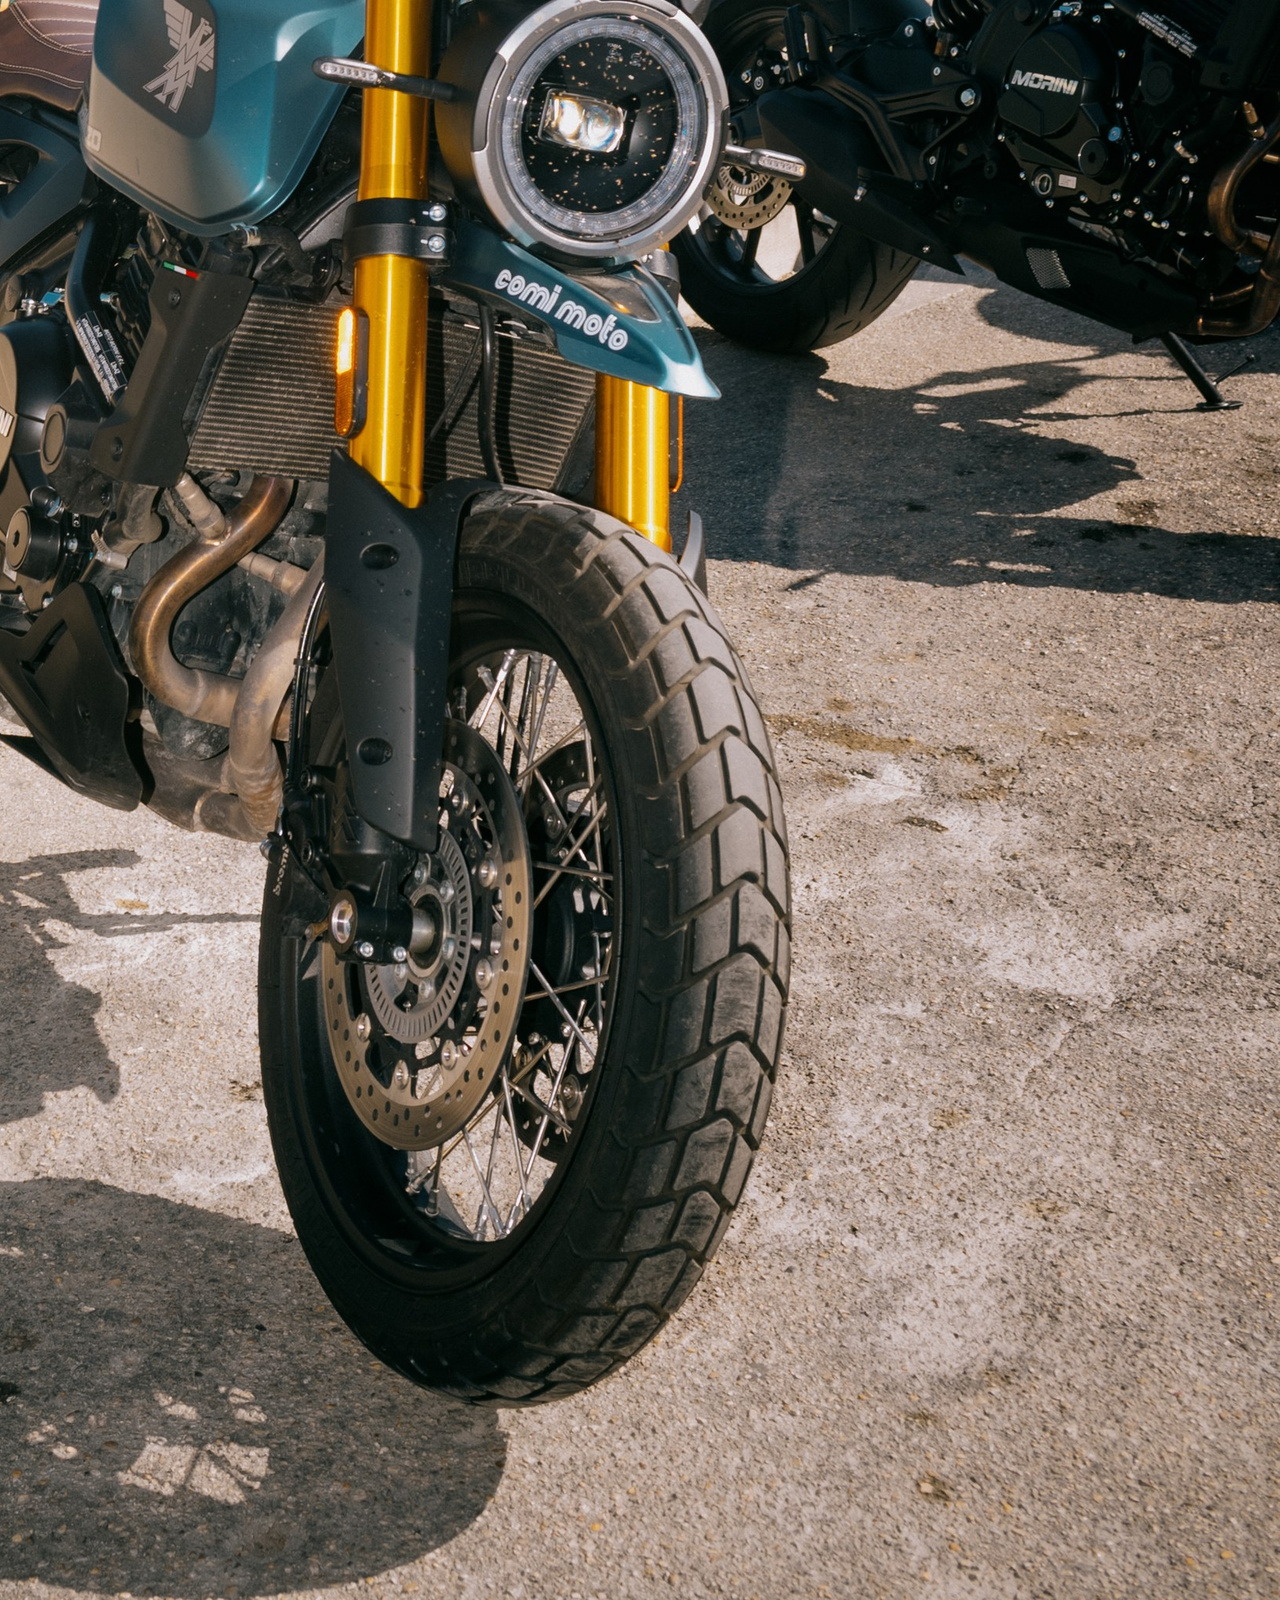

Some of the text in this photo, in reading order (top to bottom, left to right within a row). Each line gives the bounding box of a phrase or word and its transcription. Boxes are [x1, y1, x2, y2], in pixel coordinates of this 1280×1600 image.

[1011, 69, 1080, 97] MORINI
[494, 269, 629, 351] comi moto
